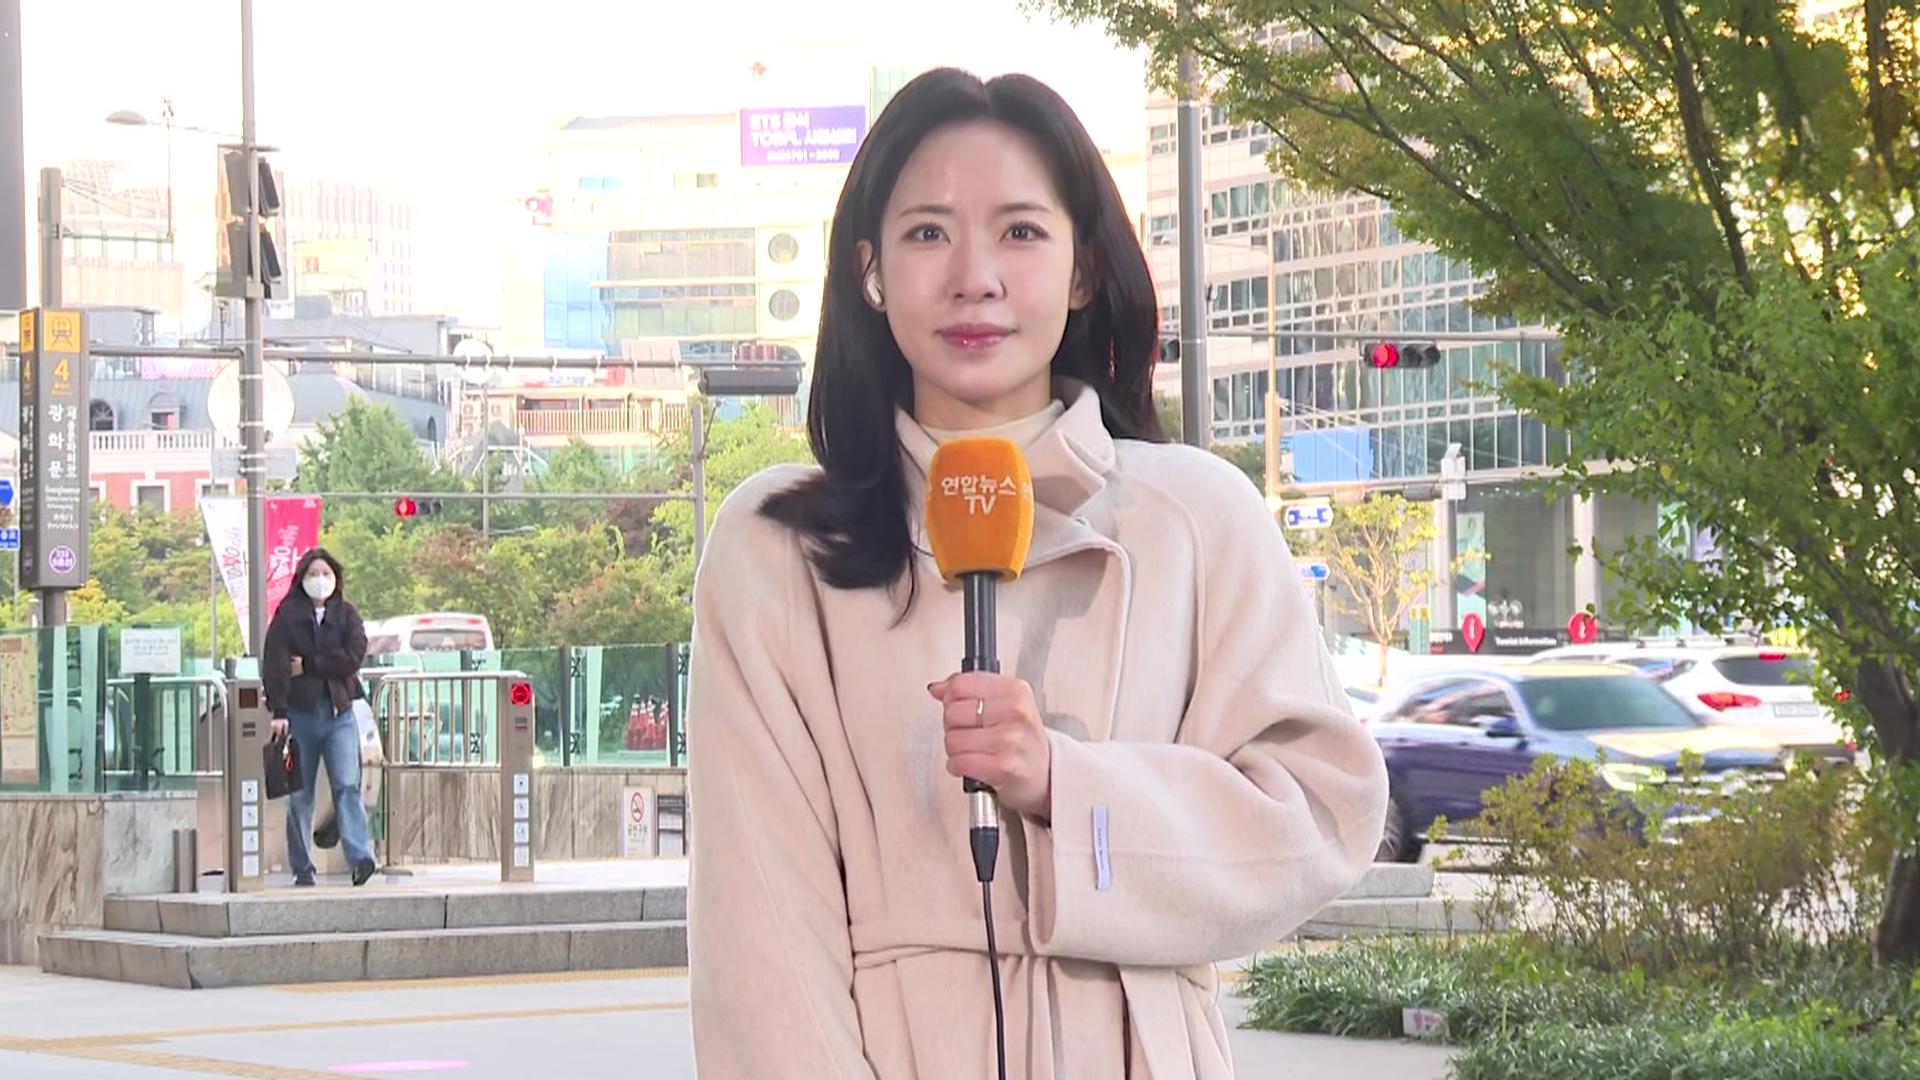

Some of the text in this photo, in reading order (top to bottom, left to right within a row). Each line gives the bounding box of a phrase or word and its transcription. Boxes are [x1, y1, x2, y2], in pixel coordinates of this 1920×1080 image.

[54, 358, 71, 382] 4
[48, 403, 64, 478] 광화문
[941, 474, 1017, 496] 연합뉴스
[964, 495, 997, 515] TV
